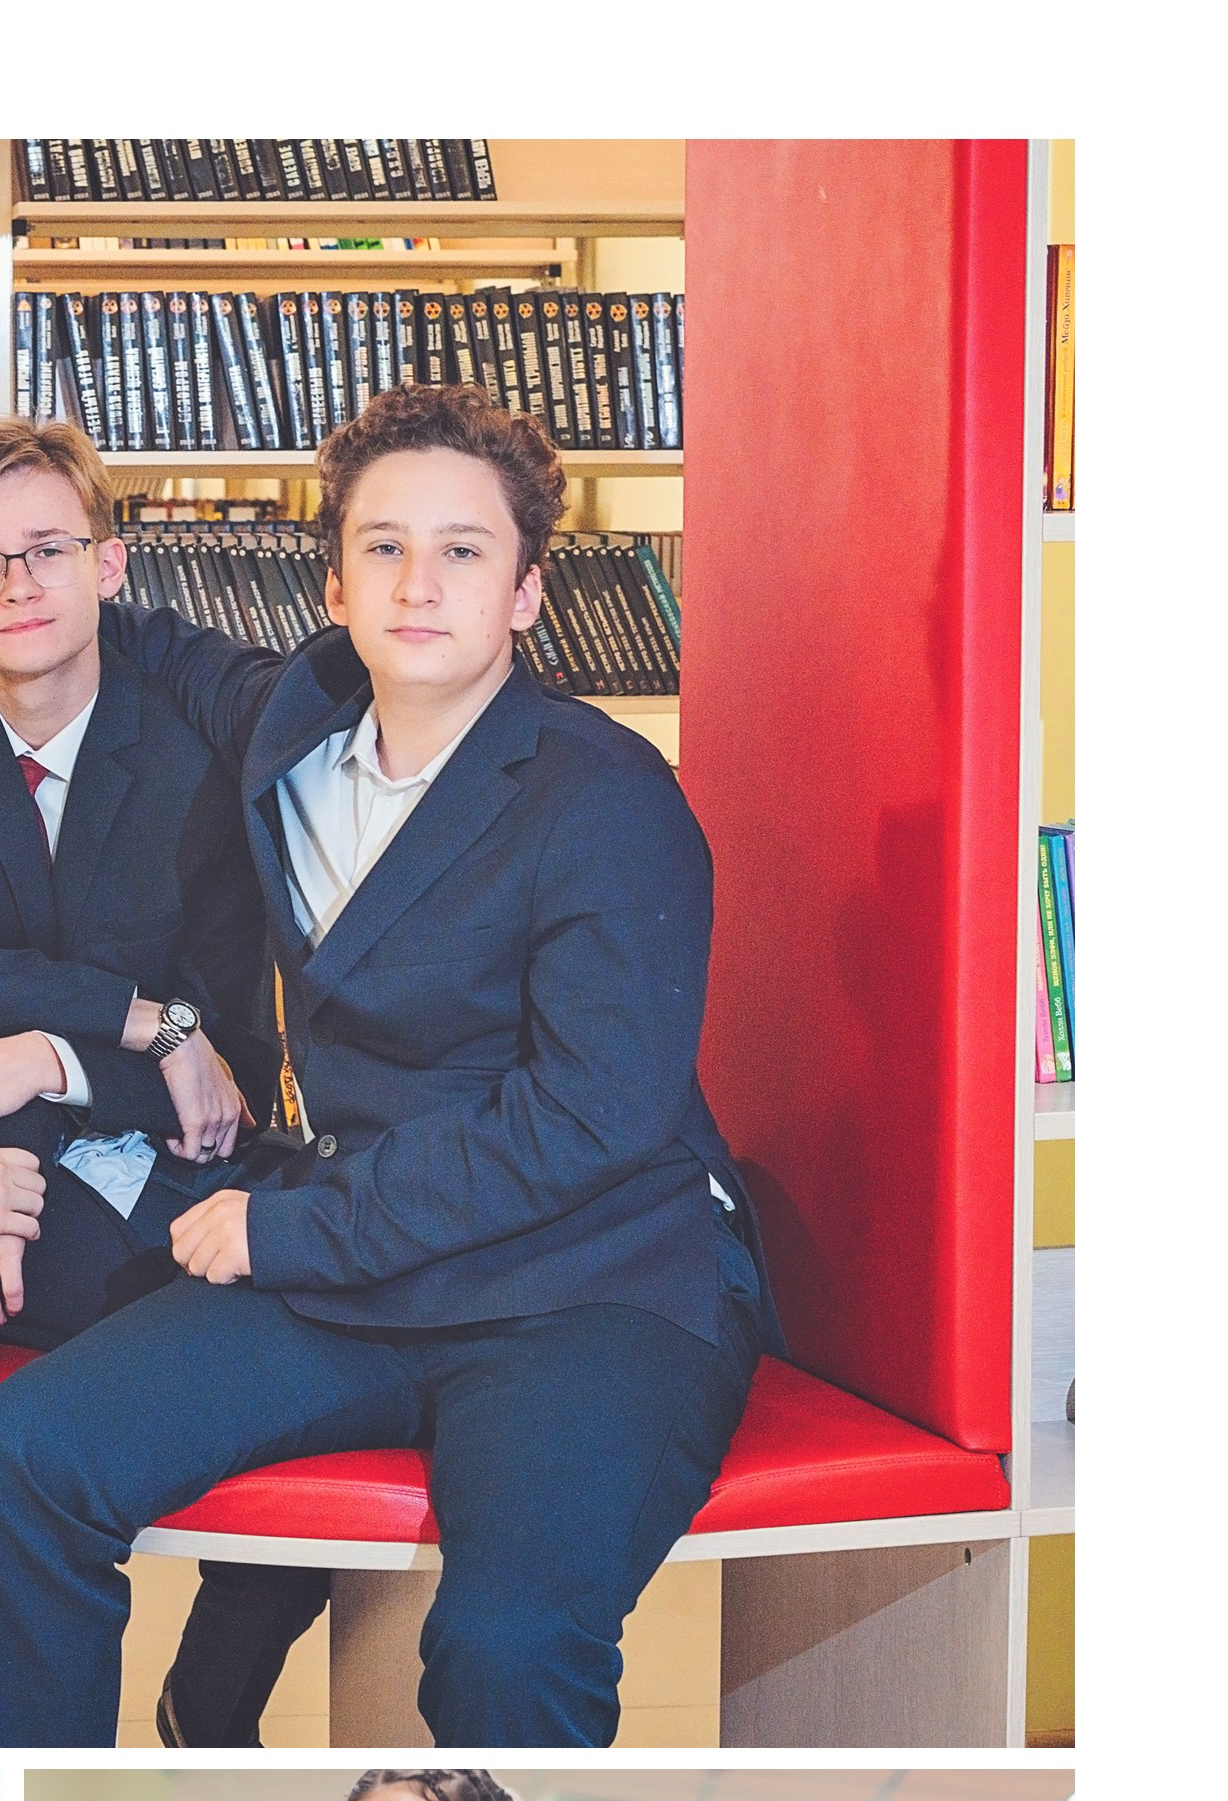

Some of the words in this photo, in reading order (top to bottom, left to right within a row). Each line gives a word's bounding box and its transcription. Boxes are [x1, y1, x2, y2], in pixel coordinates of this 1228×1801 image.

[278, 145, 302, 186] СЛЕПОЕ
[1060, 313, 1070, 344] Мейзи
[75, 349, 94, 385] ОГОНЬ
[40, 361, 52, 415] ОСОЗНАНИЕ
[81, 389, 102, 434] БЕГЛЫЙ
[232, 609, 245, 635] СЕСТРЫ
[641, 615, 652, 636] КРЫМ
[558, 636, 579, 674] ДМИТРИЙ
[1040, 868, 1049, 888] БЫТЬ
[1042, 888, 1051, 909] ХОЧУ
[1044, 909, 1052, 920] НЕ
[1046, 921, 1054, 936] ИЛИ
[1050, 960, 1060, 987] ЩЕНОК
[1052, 996, 1062, 1015] Вебб
[1055, 1016, 1066, 1041] Холли
